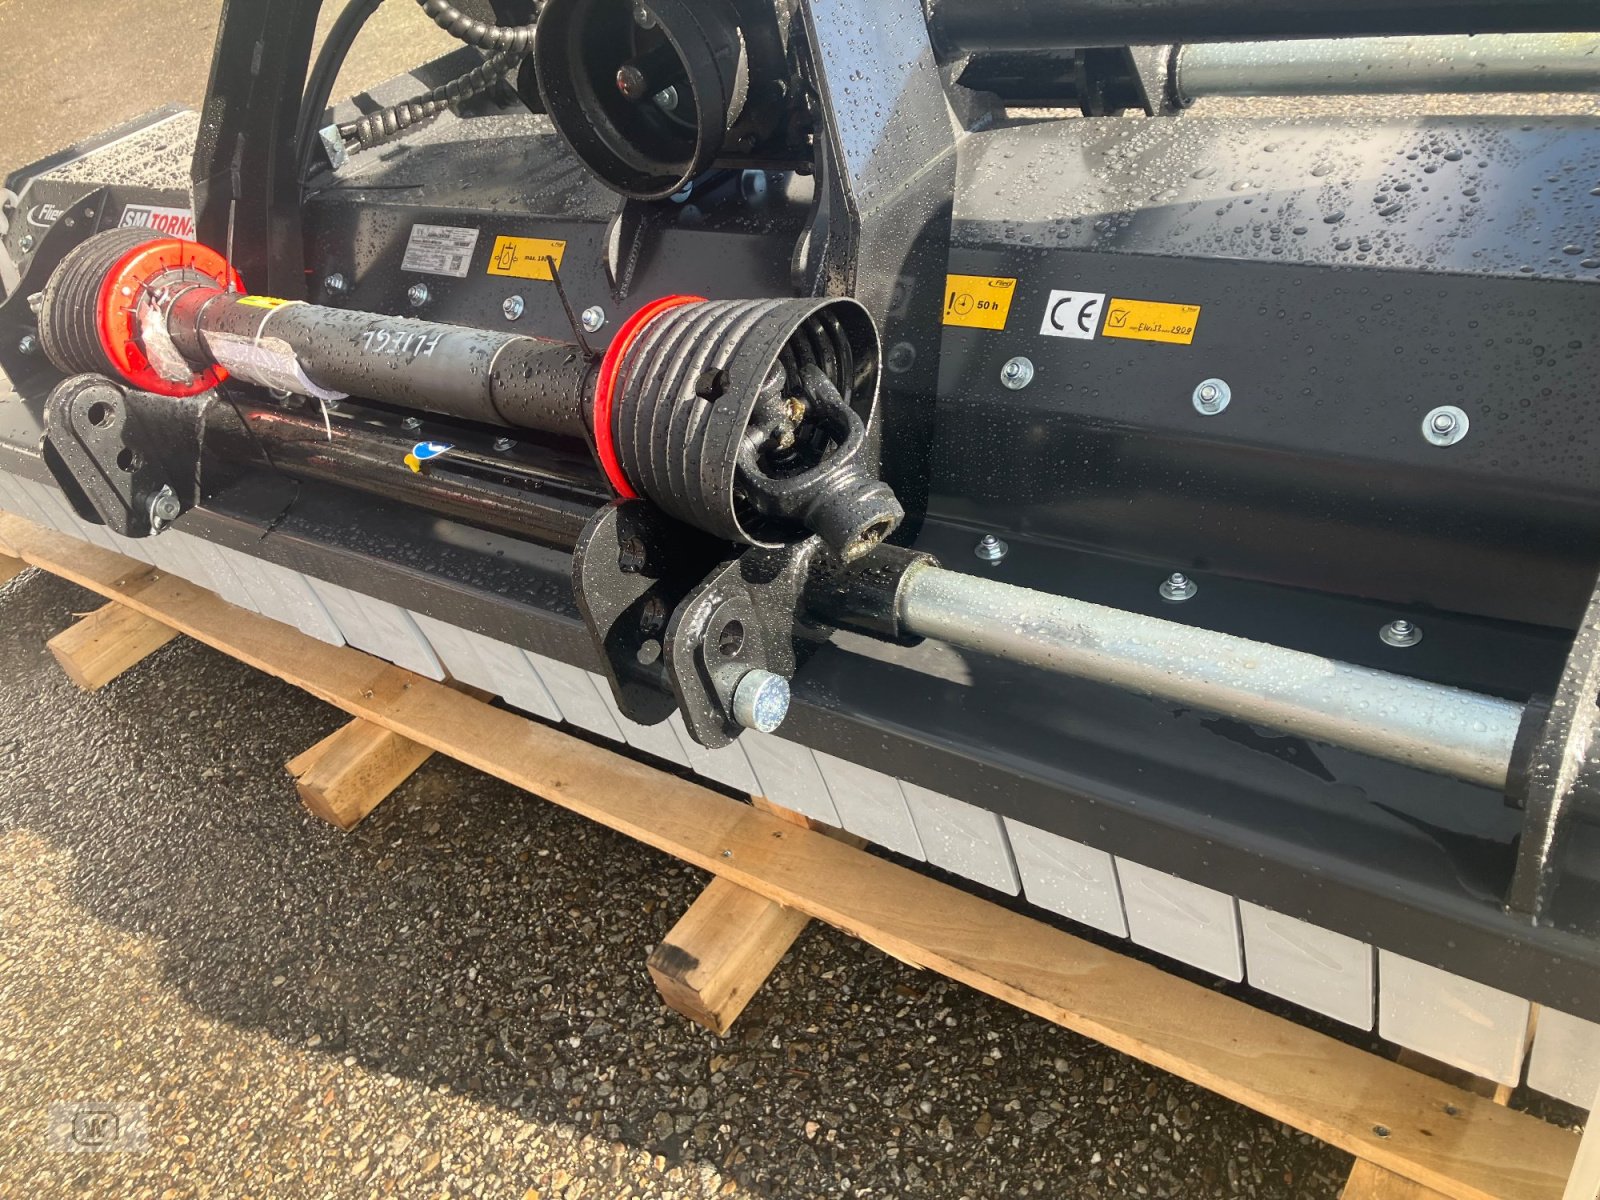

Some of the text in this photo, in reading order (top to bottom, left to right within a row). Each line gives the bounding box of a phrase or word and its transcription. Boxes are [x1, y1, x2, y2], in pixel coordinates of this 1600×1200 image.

[122, 211, 149, 228] SM
[977, 301, 999, 310] 50 h
[1051, 297, 1097, 333] CE
[363, 329, 446, 357] FLIEGL
